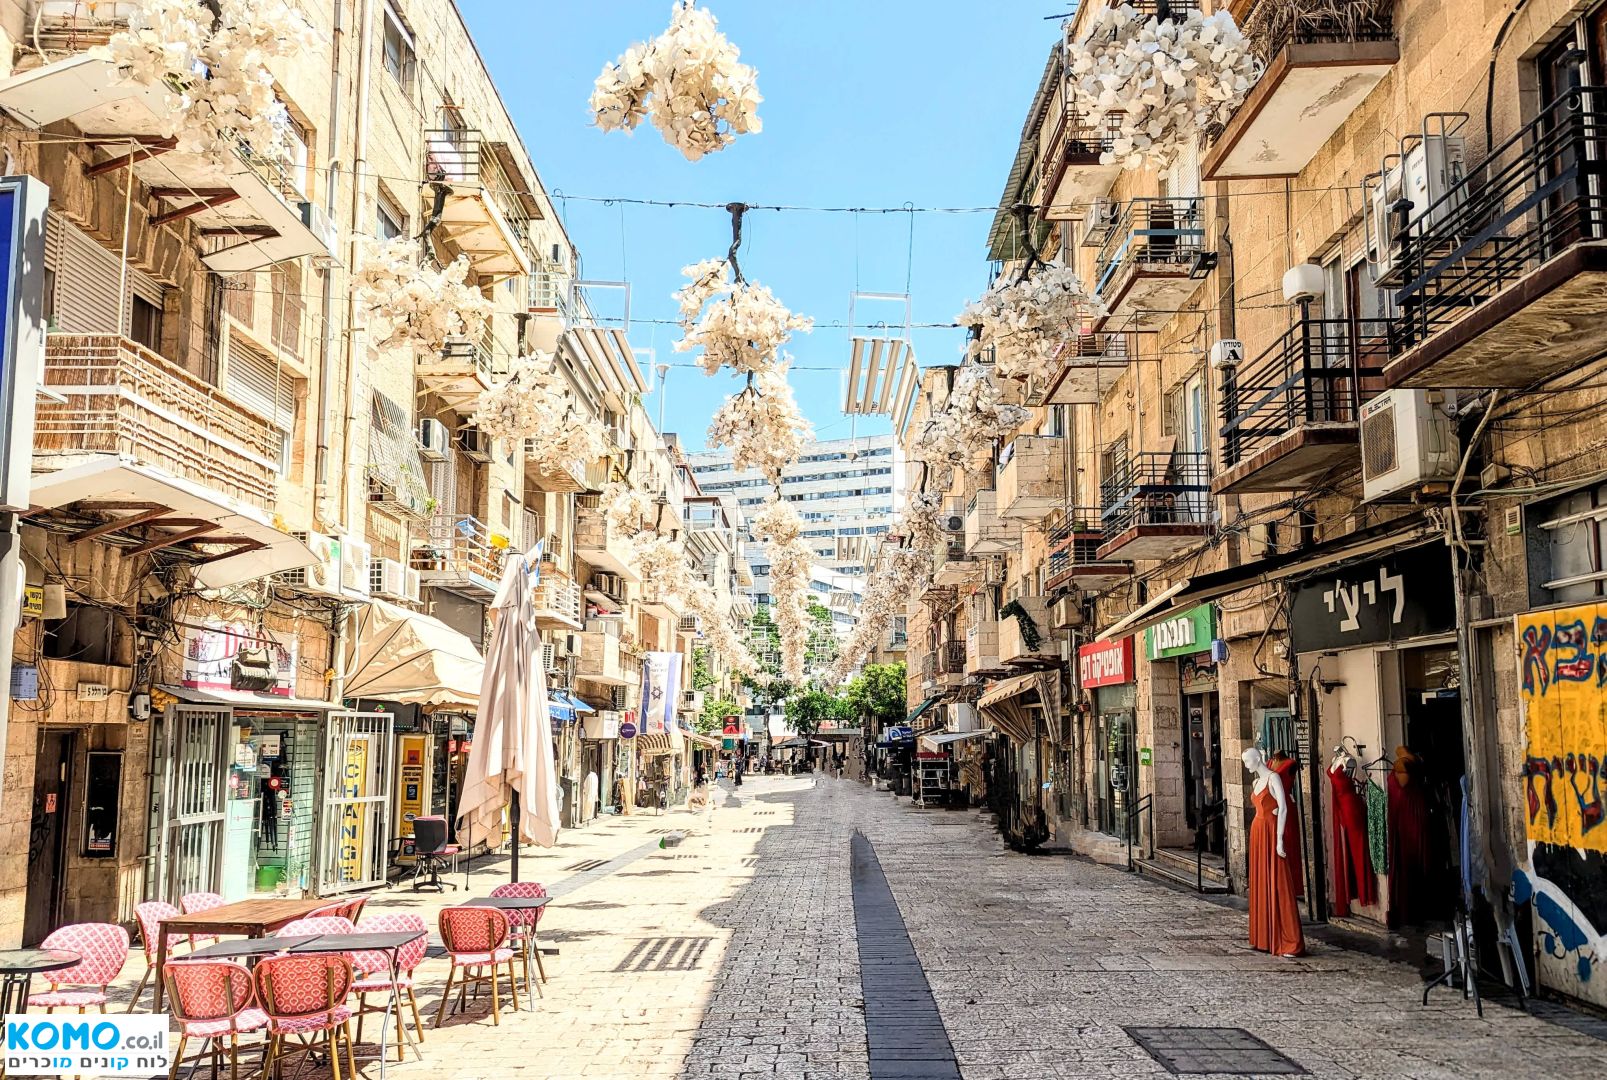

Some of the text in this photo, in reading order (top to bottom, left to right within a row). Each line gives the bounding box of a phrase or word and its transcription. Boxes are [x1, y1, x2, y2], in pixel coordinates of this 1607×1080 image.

[1225, 349, 1241, 360] A
[1368, 396, 1391, 414] ELECTRA
[1324, 567, 1404, 632] ליצ'י
[1092, 647, 1123, 684] אופטיקה
[339, 763, 360, 881] CHANGE
